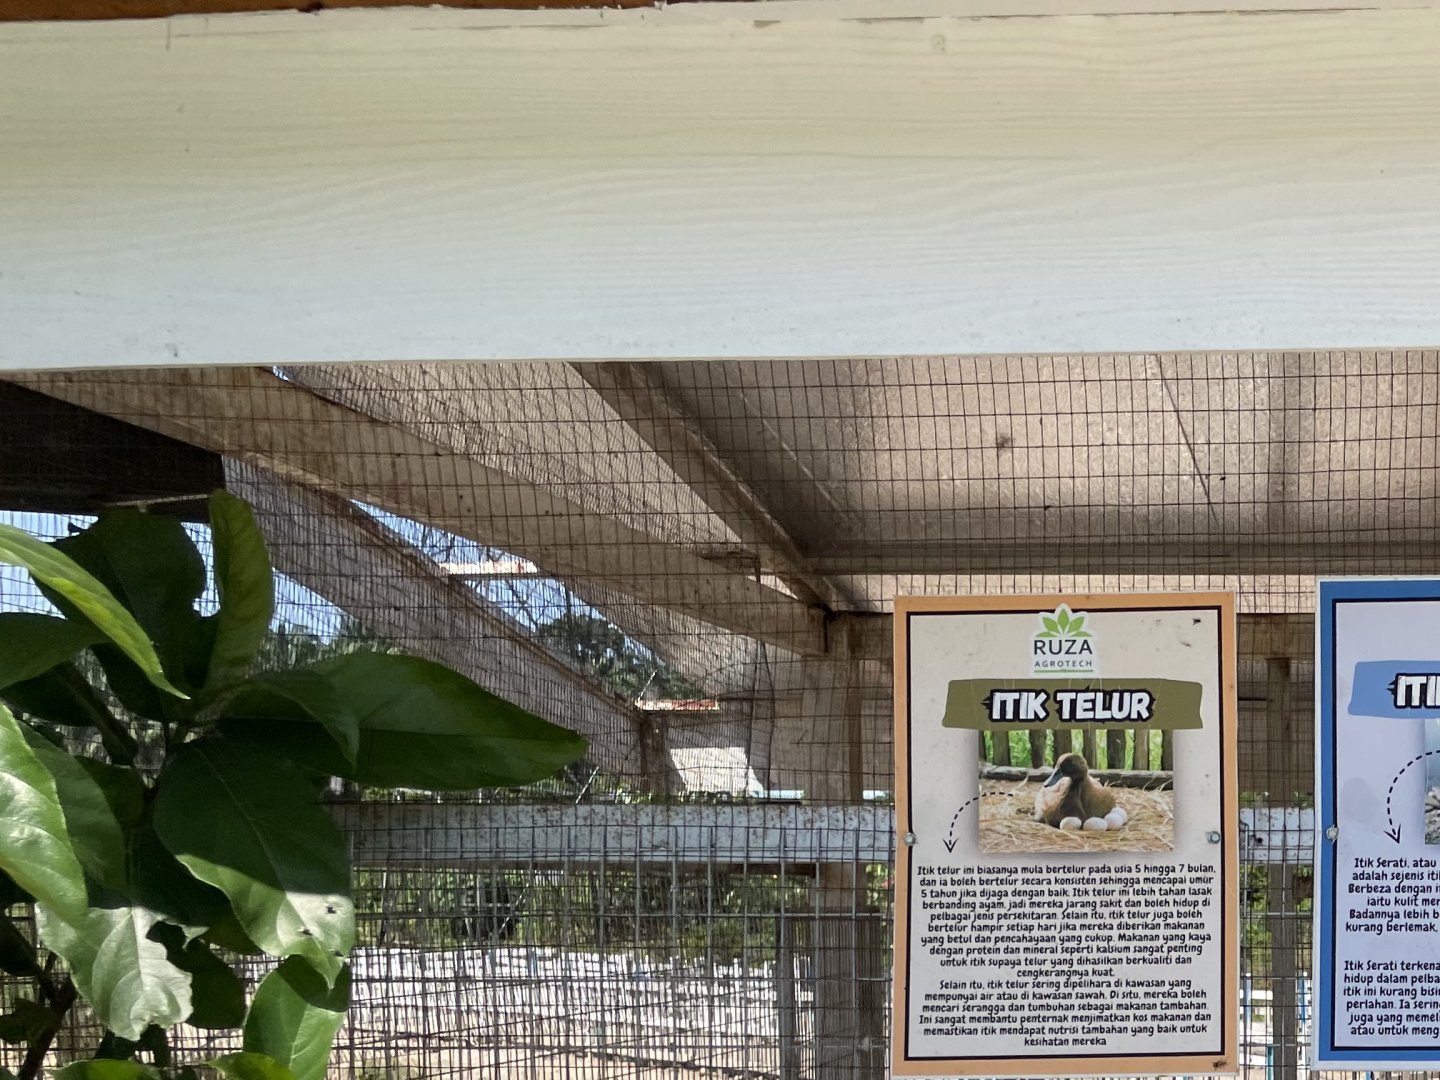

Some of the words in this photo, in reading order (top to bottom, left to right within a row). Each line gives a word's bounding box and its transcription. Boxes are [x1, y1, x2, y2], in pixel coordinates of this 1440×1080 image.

[1034, 640, 1093, 656] RUZA
[1034, 660, 1093, 668] AGROTECH
[991, 692, 1047, 720] ITIK
[1056, 691, 1152, 720] TELUR
[1354, 858, 1373, 867] Itik
[1413, 858, 1436, 867] atau
[917, 866, 934, 874] Itik
[937, 866, 960, 874] telur
[963, 866, 974, 874] ini
[977, 865, 1018, 877] biasanya
[1021, 865, 1043, 874] mula
[1046, 865, 1086, 874] bertelur
[1089, 865, 1111, 876] pada
[1115, 865, 1132, 873] usia
[1135, 864, 1141, 873] 5
[1144, 864, 1176, 876] hingga
[1179, 864, 1184, 873] 7
[920, 877, 936, 886] dan
[940, 877, 947, 886] ia
[951, 877, 976, 885] boleh
[979, 877, 1018, 885] bertelur
[1055, 876, 1096, 885] konsisten
[1099, 876, 1140, 887] sehingga
[1143, 876, 1186, 887] mencapai
[1352, 871, 1387, 880] adalah
[1391, 871, 1424, 883] sejenis
[1017, 968, 1089, 979] cengkerangnya
[1024, 1036, 1069, 1046] kesihatan
[1072, 1036, 1106, 1045] mereka
